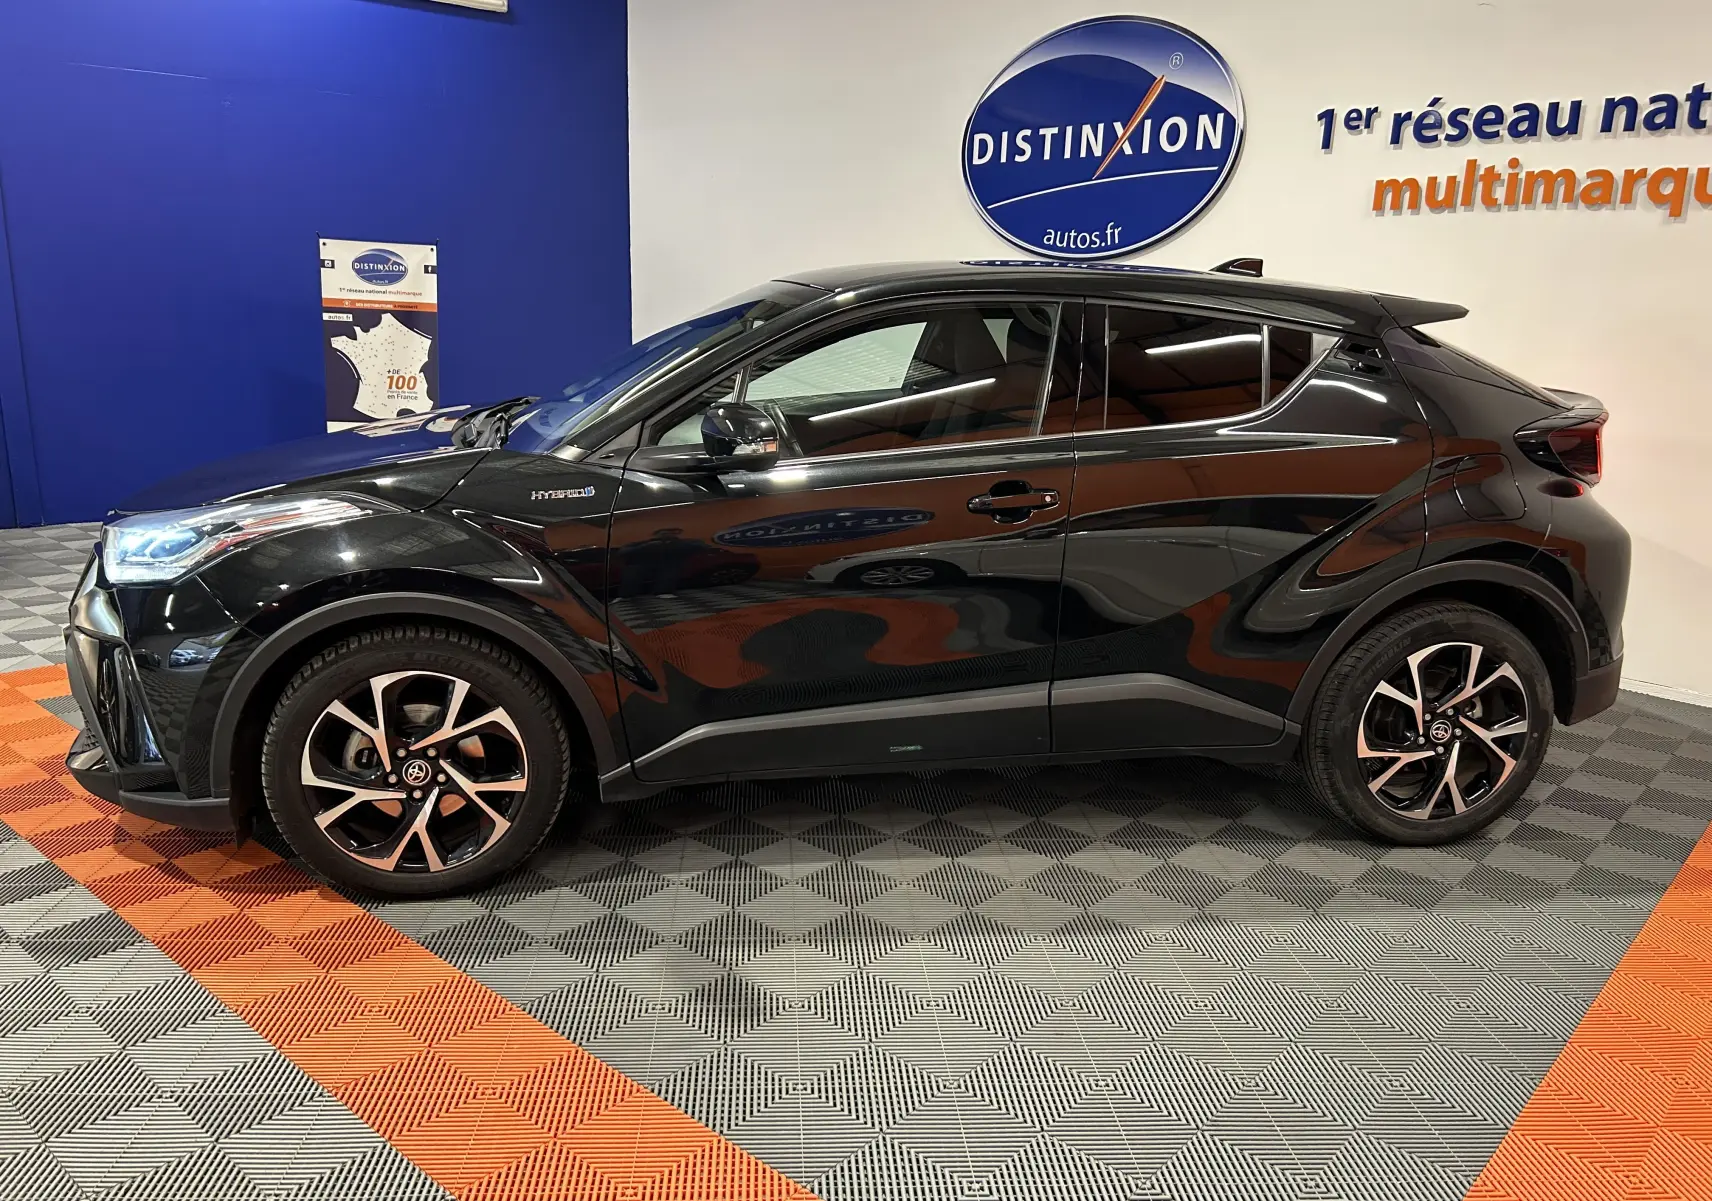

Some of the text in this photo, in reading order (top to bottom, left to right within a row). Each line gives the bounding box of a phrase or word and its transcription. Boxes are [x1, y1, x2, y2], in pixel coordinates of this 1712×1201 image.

[1316, 105, 1379, 149] 1er
[1389, 97, 1583, 146] réseau
[971, 111, 1225, 167] DISTINXION
[1042, 221, 1122, 249] autos.fr
[354, 263, 405, 272] DISTINXION
[387, 375, 417, 390] 100
